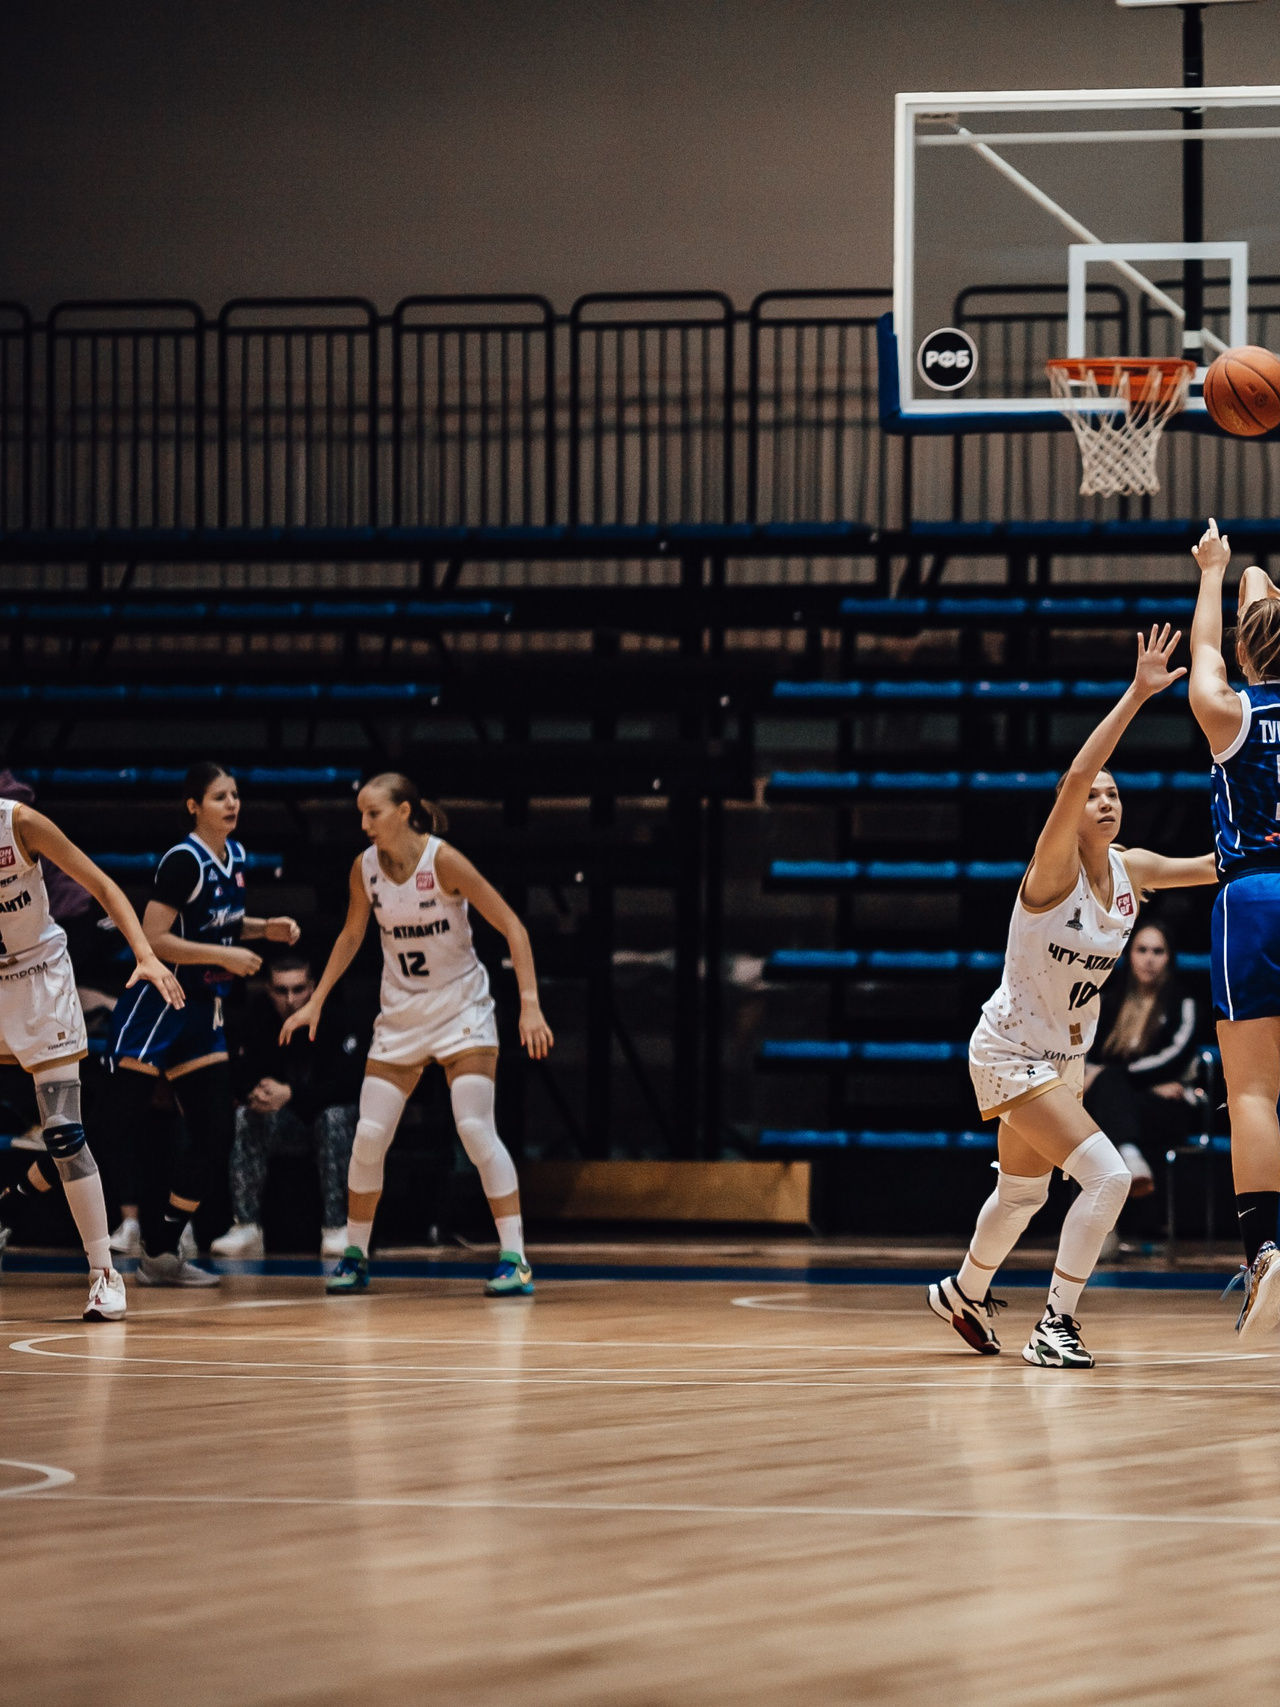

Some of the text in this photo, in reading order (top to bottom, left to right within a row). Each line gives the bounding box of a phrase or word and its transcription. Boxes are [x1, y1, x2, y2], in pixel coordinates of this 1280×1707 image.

[398, 951, 431, 978] 12
[1047, 941, 1118, 971] ЧГУ-АТЛА
[1067, 980, 1100, 1011] 10
